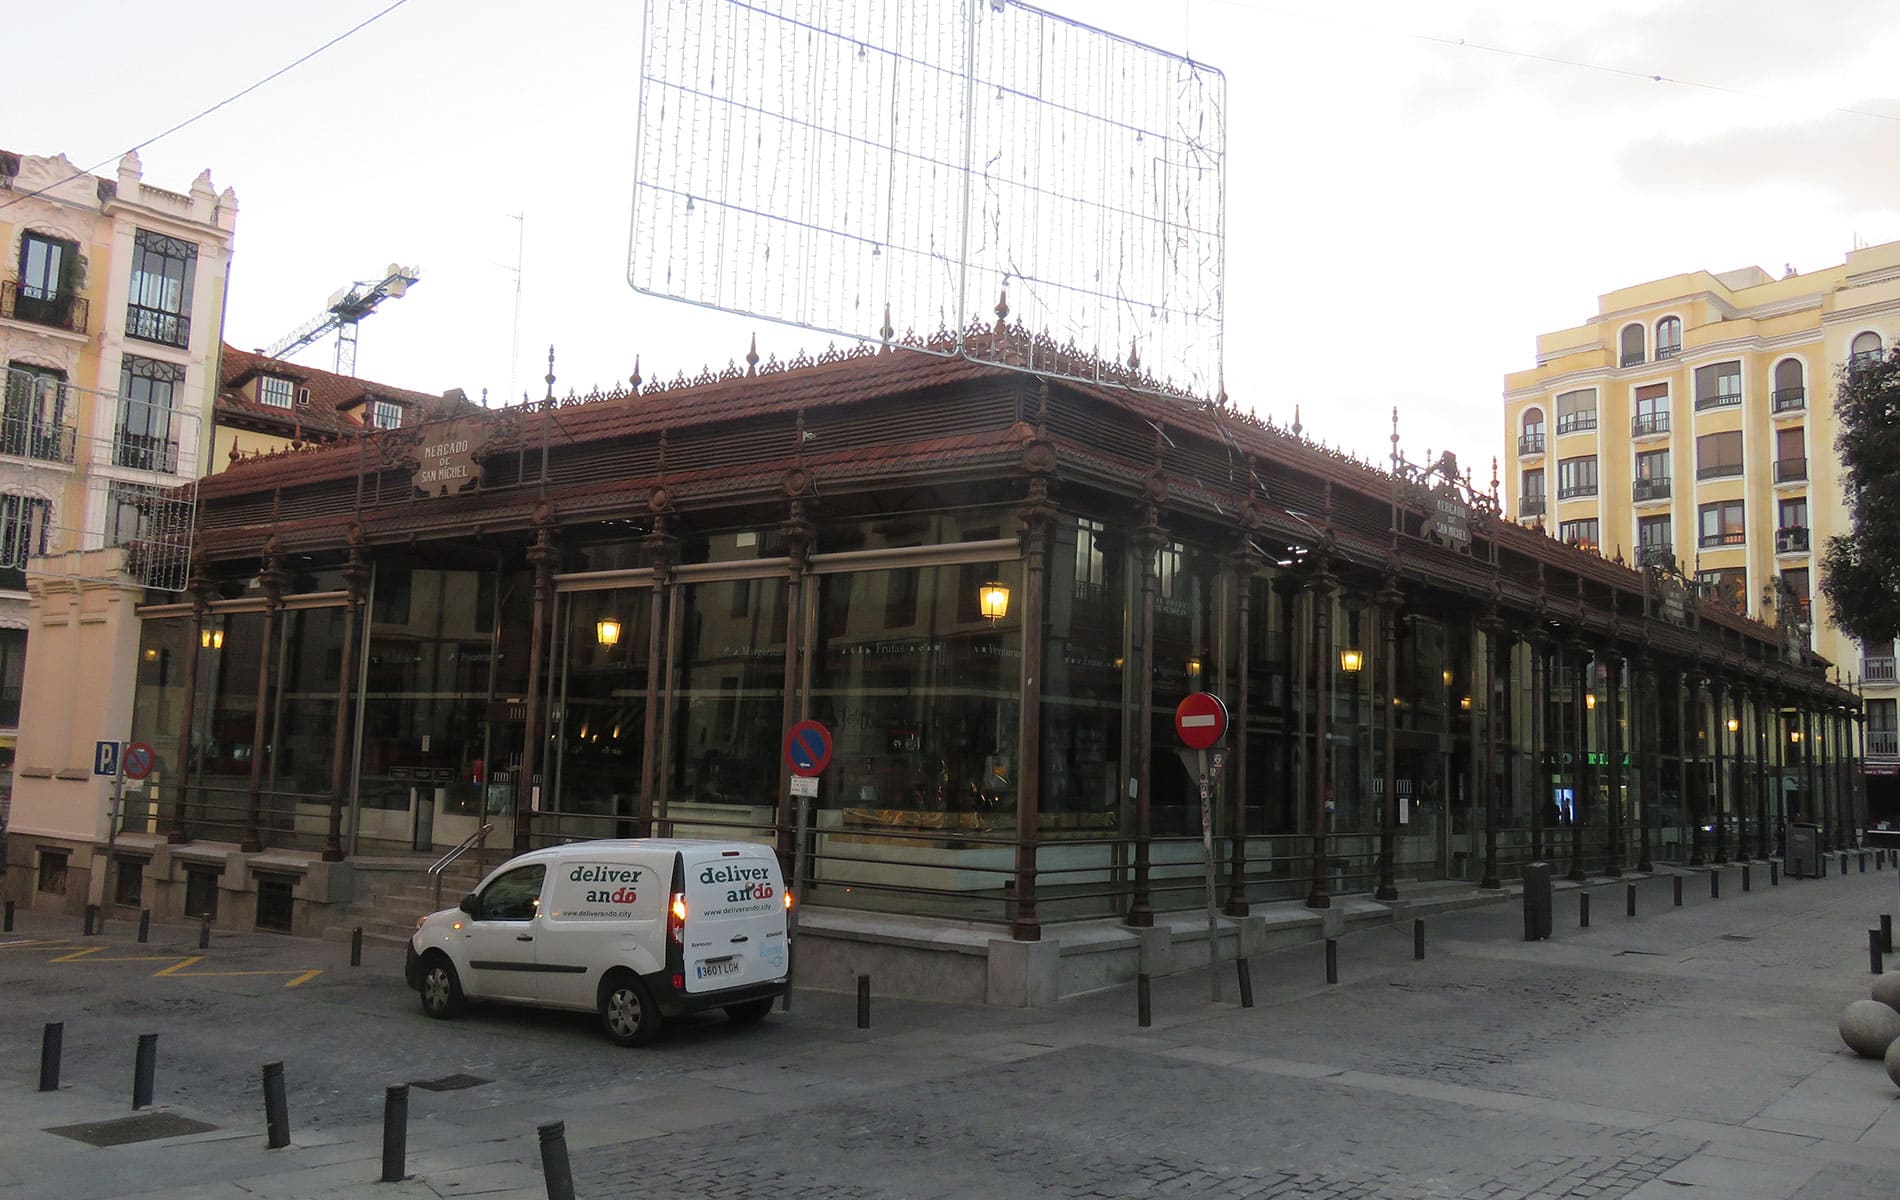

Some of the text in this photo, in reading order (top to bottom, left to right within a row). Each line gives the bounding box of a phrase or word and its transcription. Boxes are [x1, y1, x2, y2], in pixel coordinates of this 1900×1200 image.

[424, 440, 468, 458] MERCADO
[439, 457, 450, 466] DE
[421, 465, 469, 482] SAN MIGUEL
[100, 743, 113, 772] P
[569, 865, 642, 883] deliver
[700, 865, 769, 884] deliver
[704, 904, 772, 917] www.deliverando.city
[703, 964, 722, 977] 3601
